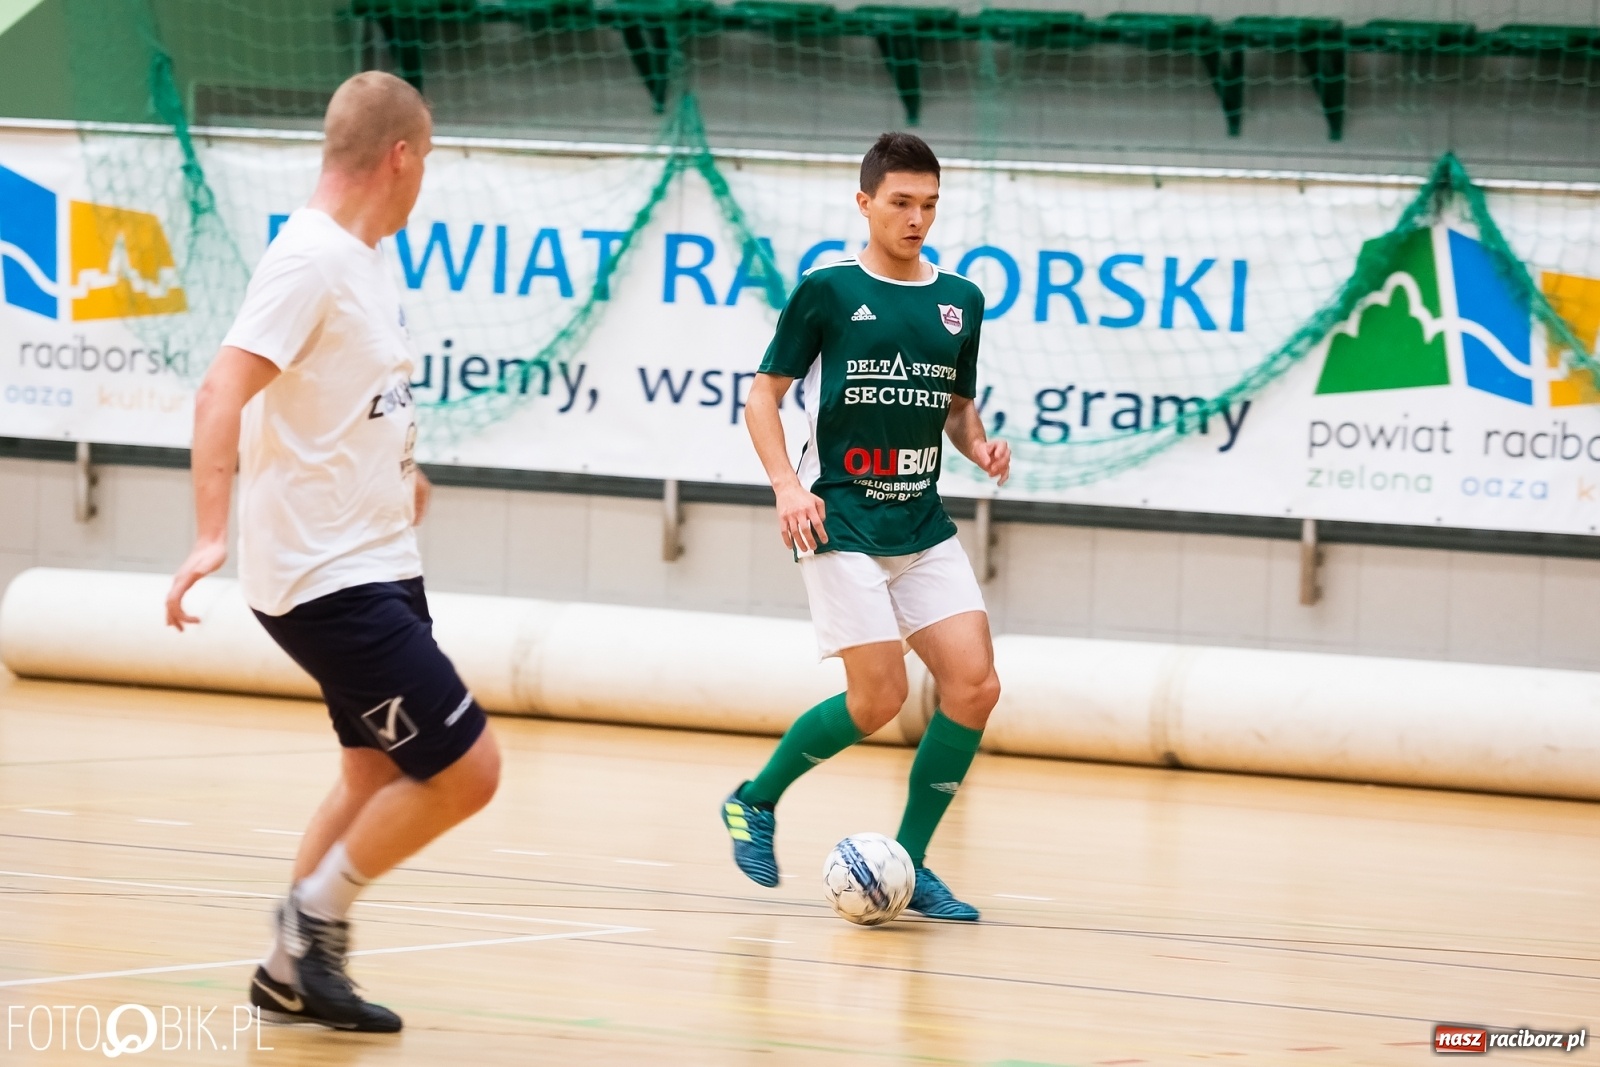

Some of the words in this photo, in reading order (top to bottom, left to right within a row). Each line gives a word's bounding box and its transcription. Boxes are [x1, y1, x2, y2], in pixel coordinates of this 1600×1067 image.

[269, 214, 628, 301] WIAT
[663, 233, 1247, 332] RACORSKI
[851, 313, 877, 322] adidas
[20, 335, 190, 376] raciborski
[5, 384, 73, 407] oaza
[1031, 385, 1252, 452] gramy
[1308, 412, 1453, 458] powiat
[1306, 464, 1433, 494] zielona
[1460, 475, 1549, 501] oaza
